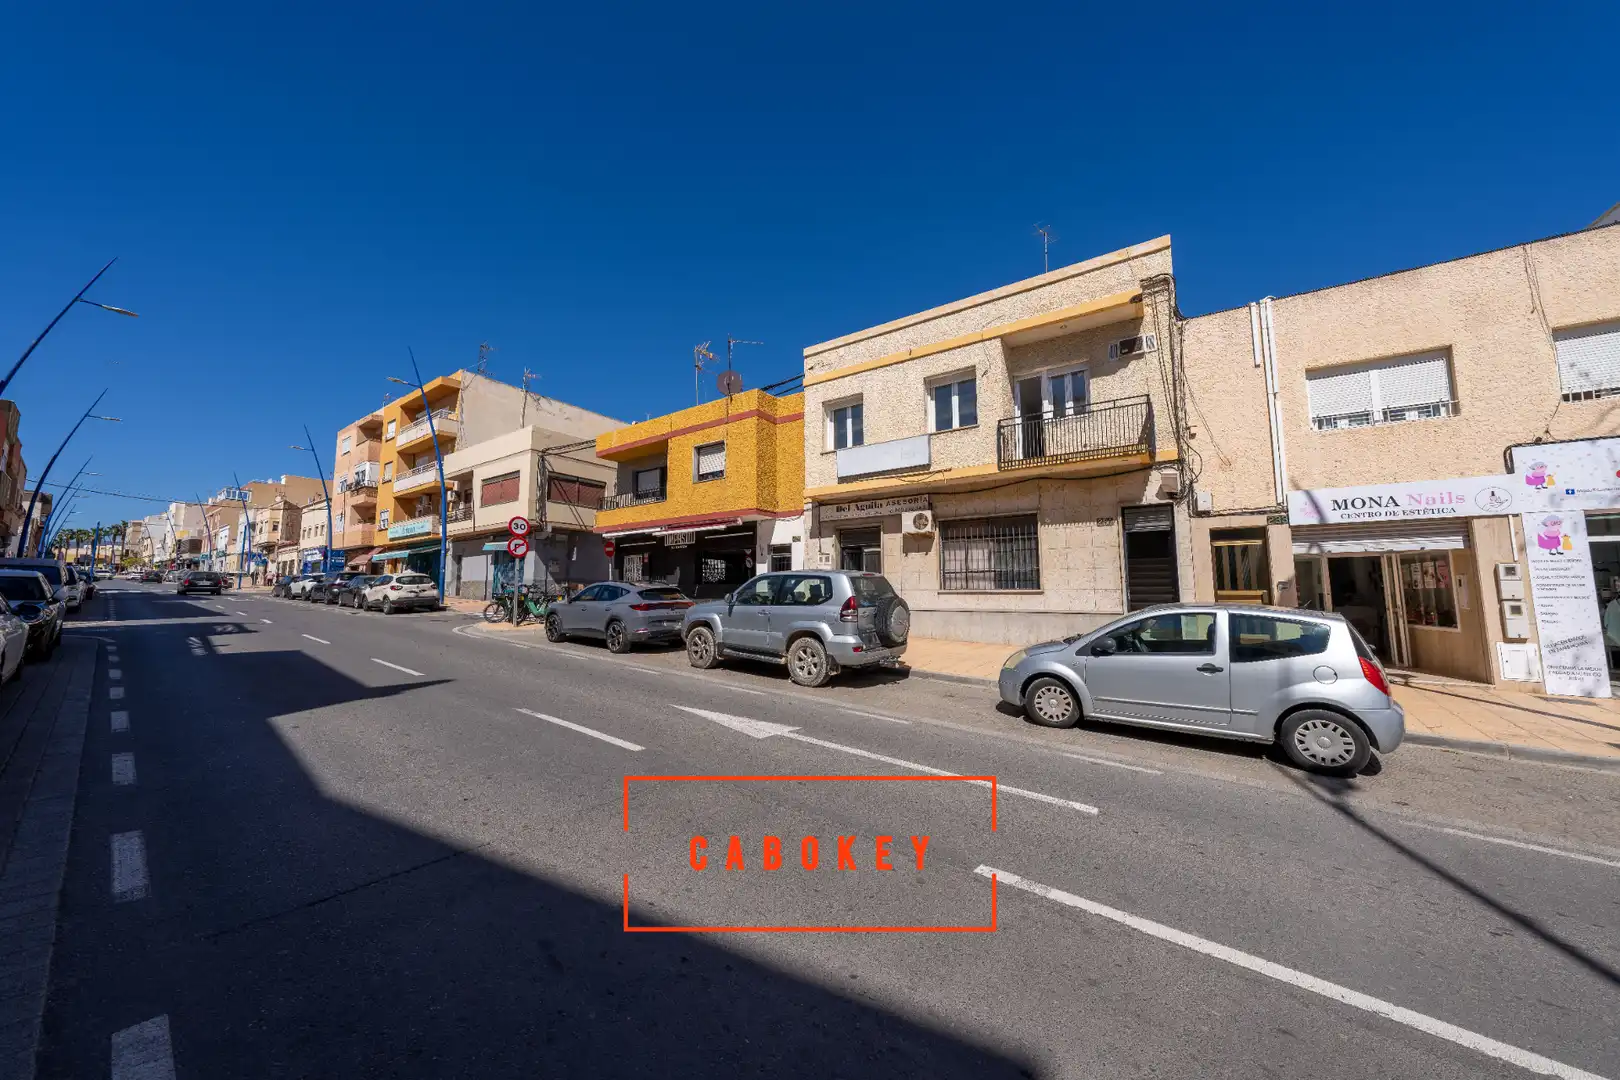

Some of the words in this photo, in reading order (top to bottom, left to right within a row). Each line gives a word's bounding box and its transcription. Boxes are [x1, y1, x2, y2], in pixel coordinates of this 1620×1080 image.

[1331, 495, 1401, 512] MONA
[1406, 491, 1466, 506] Nails
[836, 504, 851, 513] Del
[1340, 510, 1381, 520] CENTRO
[1385, 509, 1400, 517] DE
[1402, 507, 1457, 517] ESTÉTICA
[513, 522, 526, 531] 30
